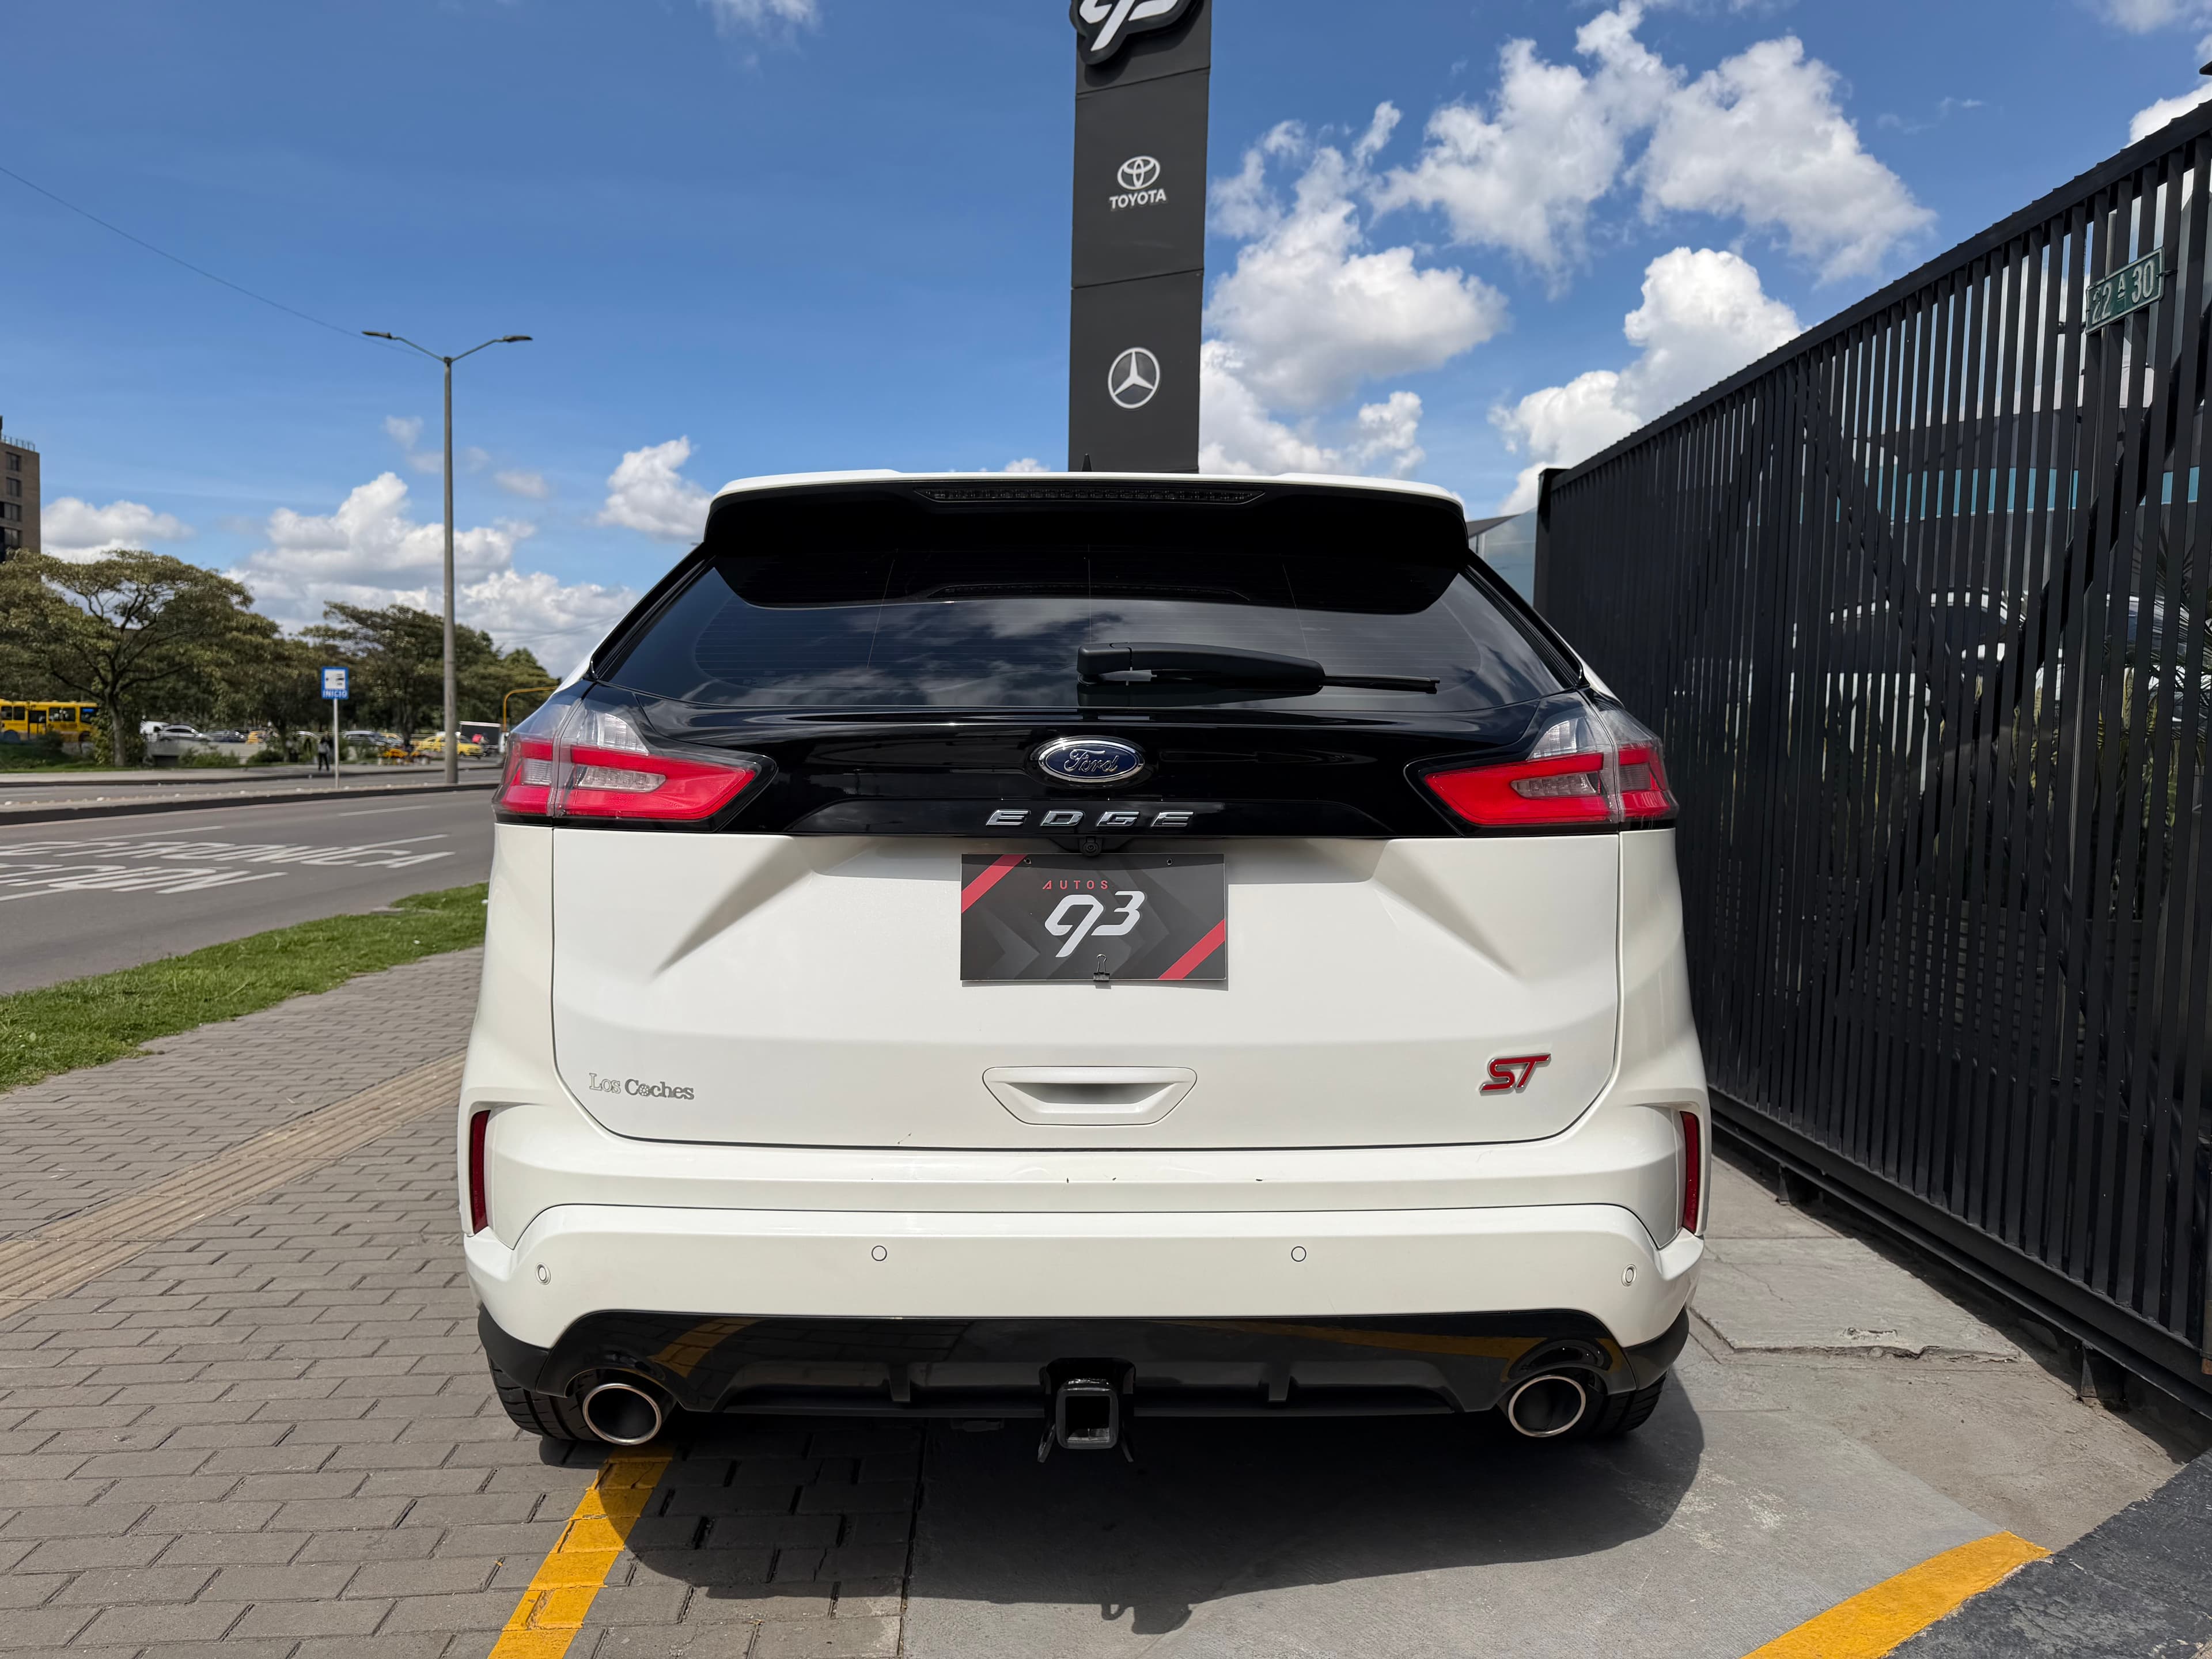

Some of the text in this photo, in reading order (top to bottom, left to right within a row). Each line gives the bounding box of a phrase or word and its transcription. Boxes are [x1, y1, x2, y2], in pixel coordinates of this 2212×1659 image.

[1109, 188, 1166, 209] TOYOTA
[2092, 282, 2113, 325] 22
[2131, 259, 2156, 304] 30
[323, 690, 348, 698] INICIO
[1063, 749, 1119, 772] Ford
[986, 809, 1195, 827] EDGE
[1042, 880, 1109, 890] AUTOS
[1044, 891, 1146, 958] 93
[589, 1072, 695, 1100] Los Coches
[1479, 1052, 1552, 1097] ST
